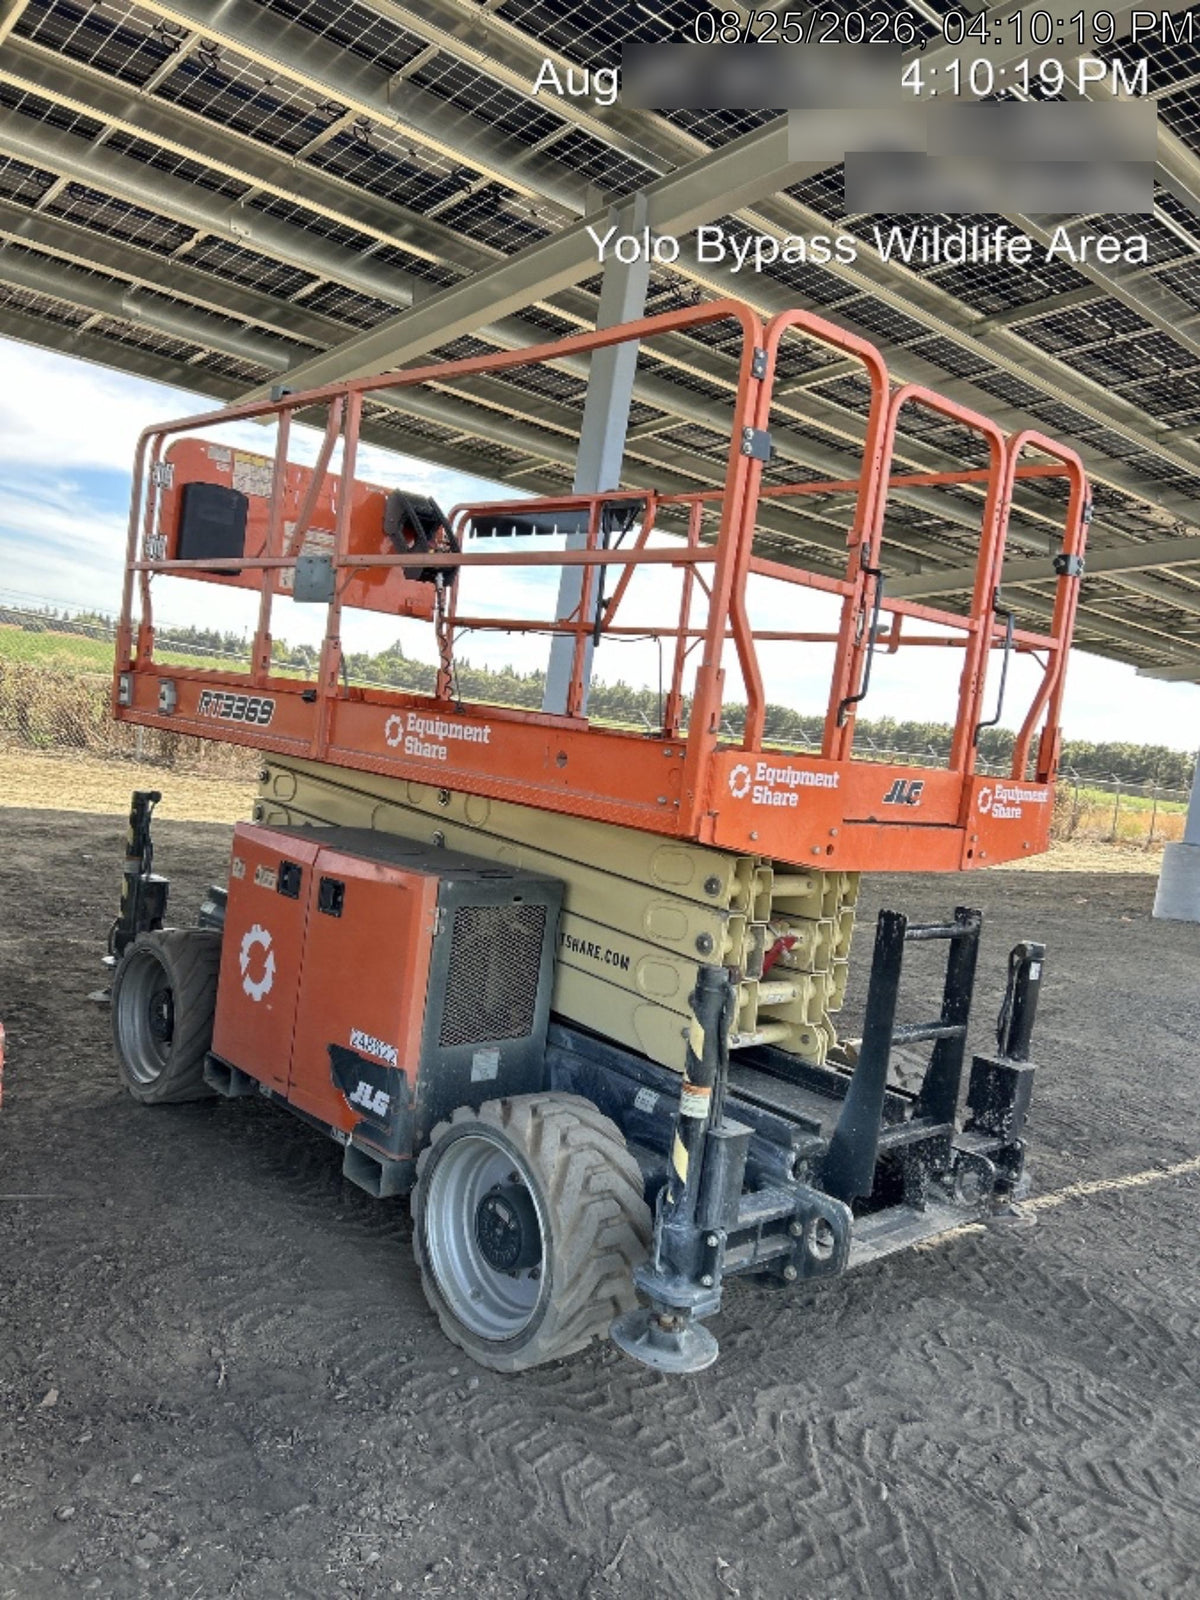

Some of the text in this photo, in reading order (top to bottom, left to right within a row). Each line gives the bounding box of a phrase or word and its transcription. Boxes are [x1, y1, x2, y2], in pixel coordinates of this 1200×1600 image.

[198, 689, 276, 727] RT3369
[406, 711, 491, 744] Equipment
[404, 735, 447, 760] Share
[755, 761, 840, 788] Equipment
[751, 785, 799, 807] Share
[882, 778, 925, 806] JLG
[993, 784, 1049, 805] Equipment
[991, 803, 1022, 819] Share
[350, 1080, 391, 1117] JLG
